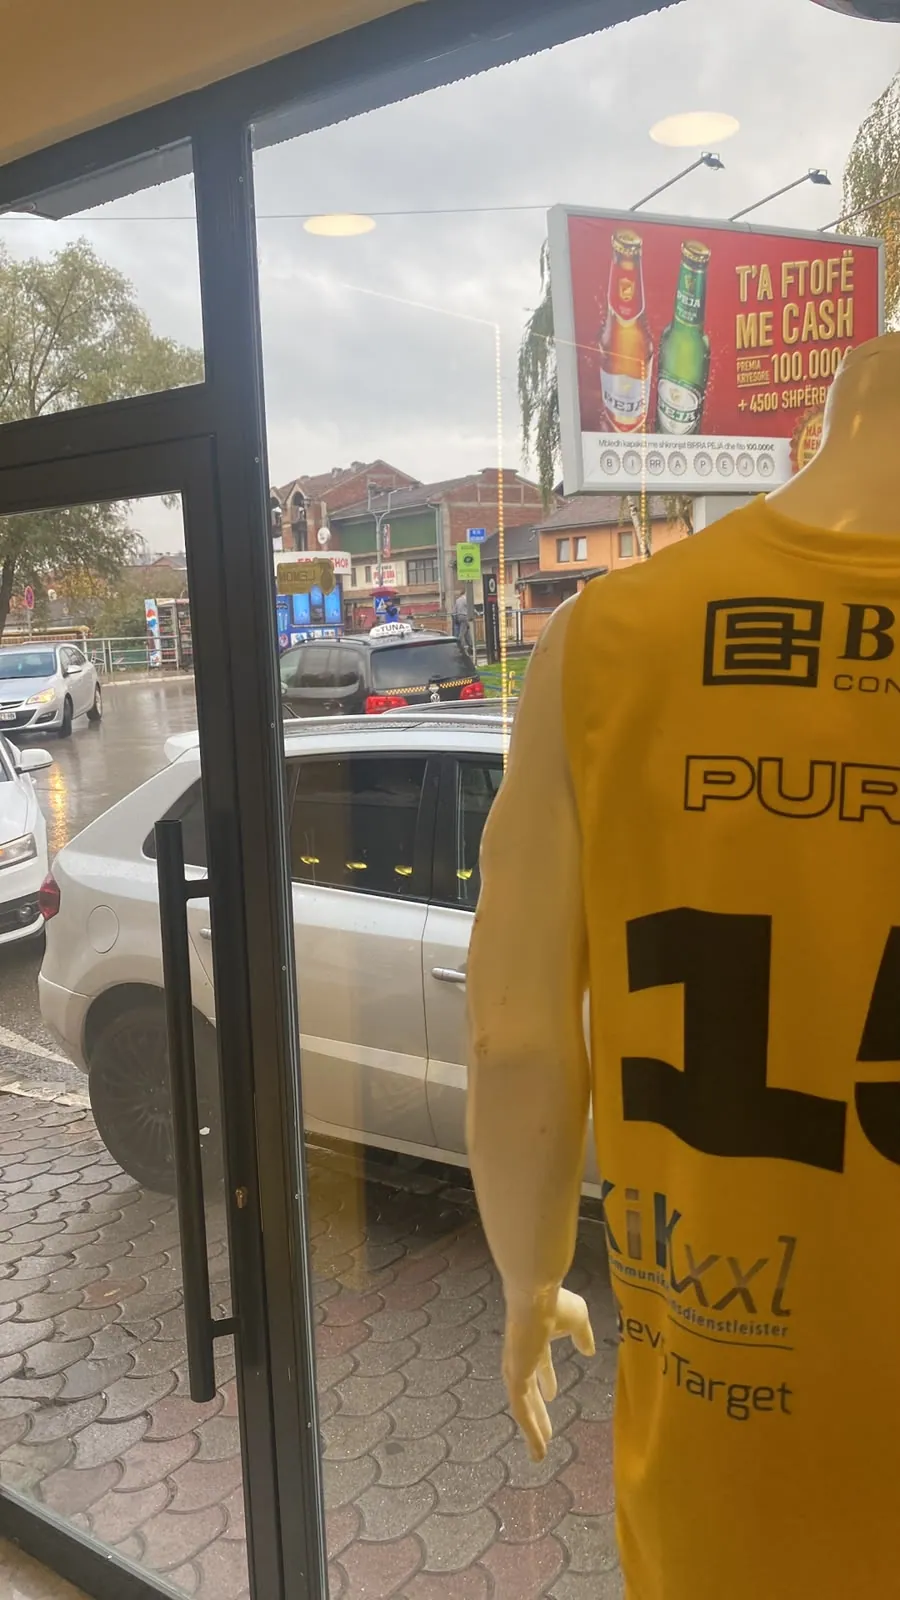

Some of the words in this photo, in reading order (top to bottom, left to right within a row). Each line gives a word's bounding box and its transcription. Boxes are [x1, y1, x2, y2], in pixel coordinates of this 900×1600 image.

[781, 249, 854, 298] FTOFË
[736, 311, 774, 349] ME
[782, 298, 854, 345] CASH
[750, 392, 779, 413] 4500
[781, 384, 829, 409] SHPËRB
[381, 623, 405, 632] TUNA
[834, 673, 900, 694] CON
[683, 755, 900, 826] PUR
